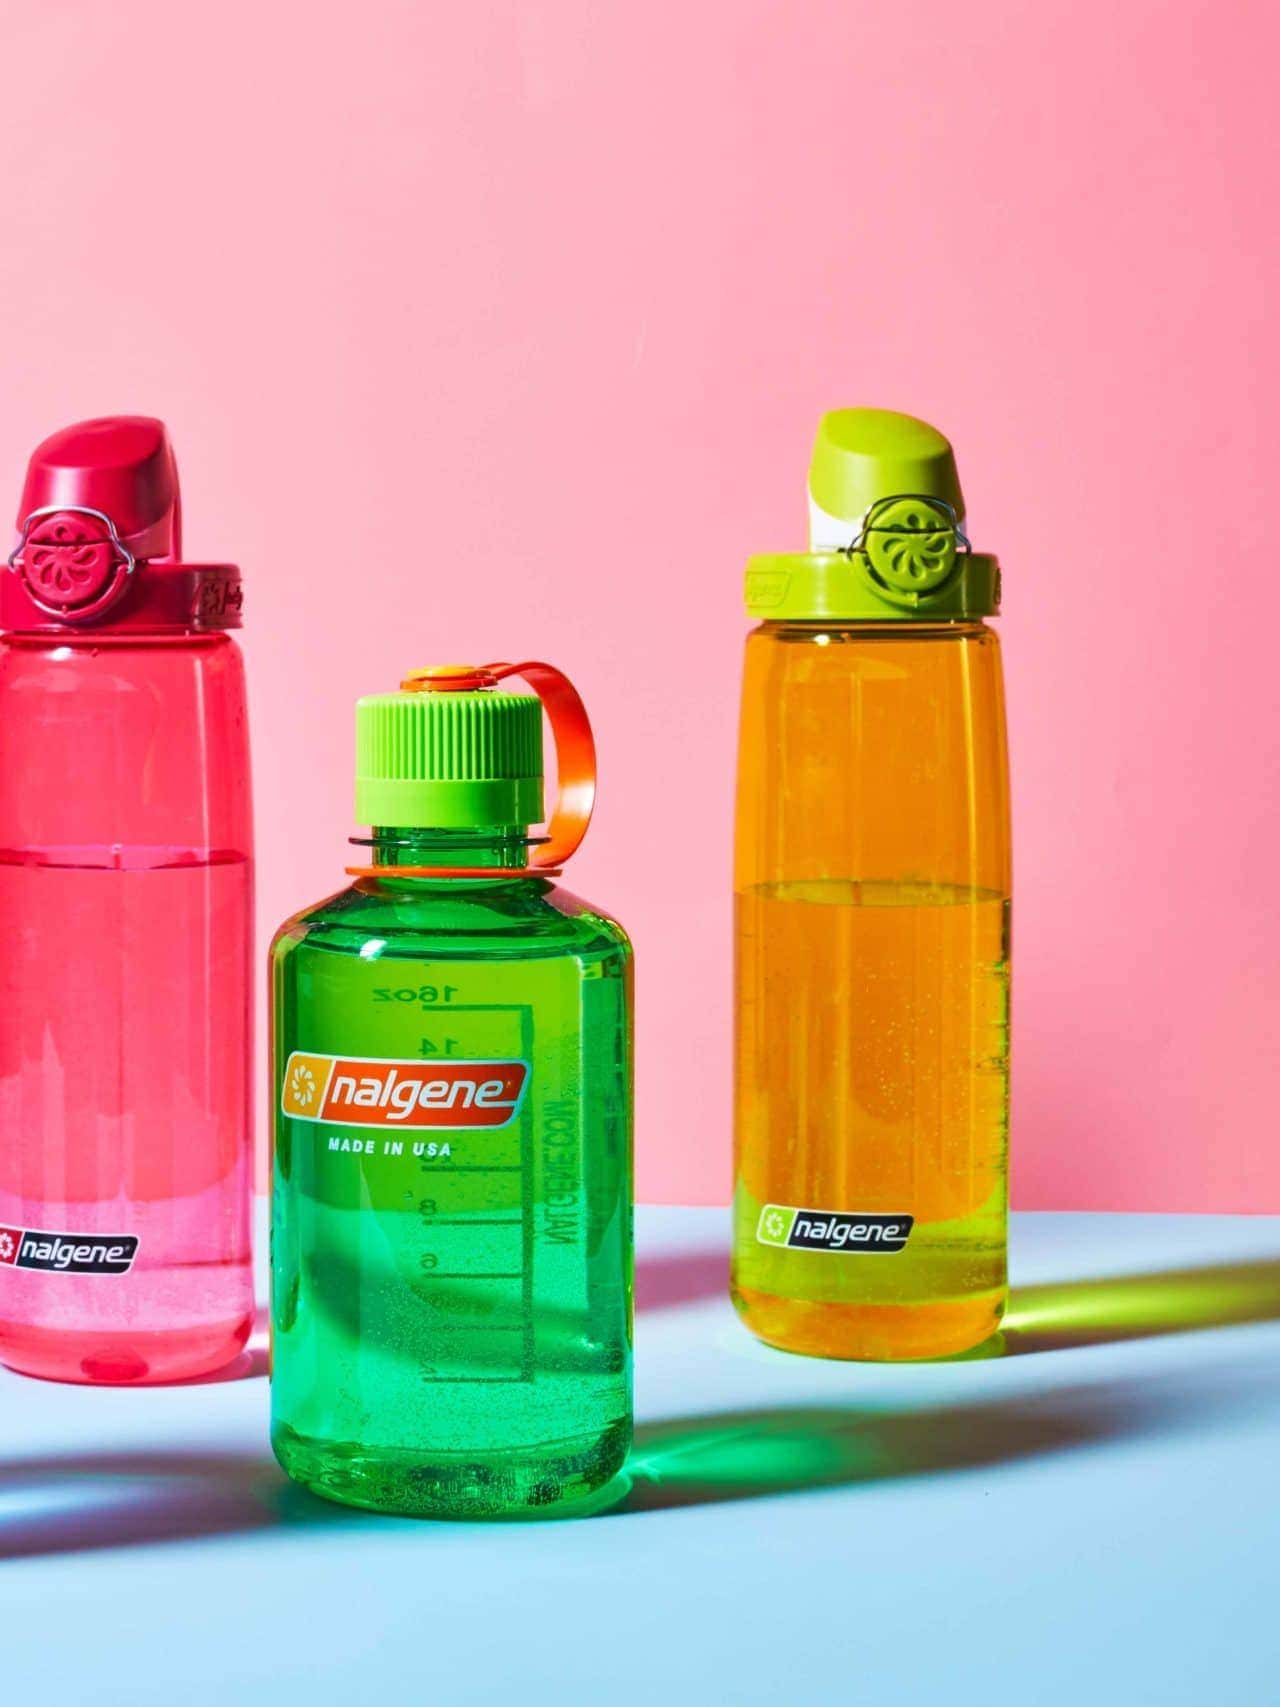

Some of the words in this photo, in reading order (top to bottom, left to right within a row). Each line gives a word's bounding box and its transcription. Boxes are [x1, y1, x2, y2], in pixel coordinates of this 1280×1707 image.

[331, 1069, 521, 1120] nalgene
[328, 1137, 375, 1155] MADE
[384, 1140, 404, 1155] IN
[412, 1141, 452, 1157] USA
[794, 1217, 909, 1248] nalgene
[21, 1237, 133, 1268] nalgene
